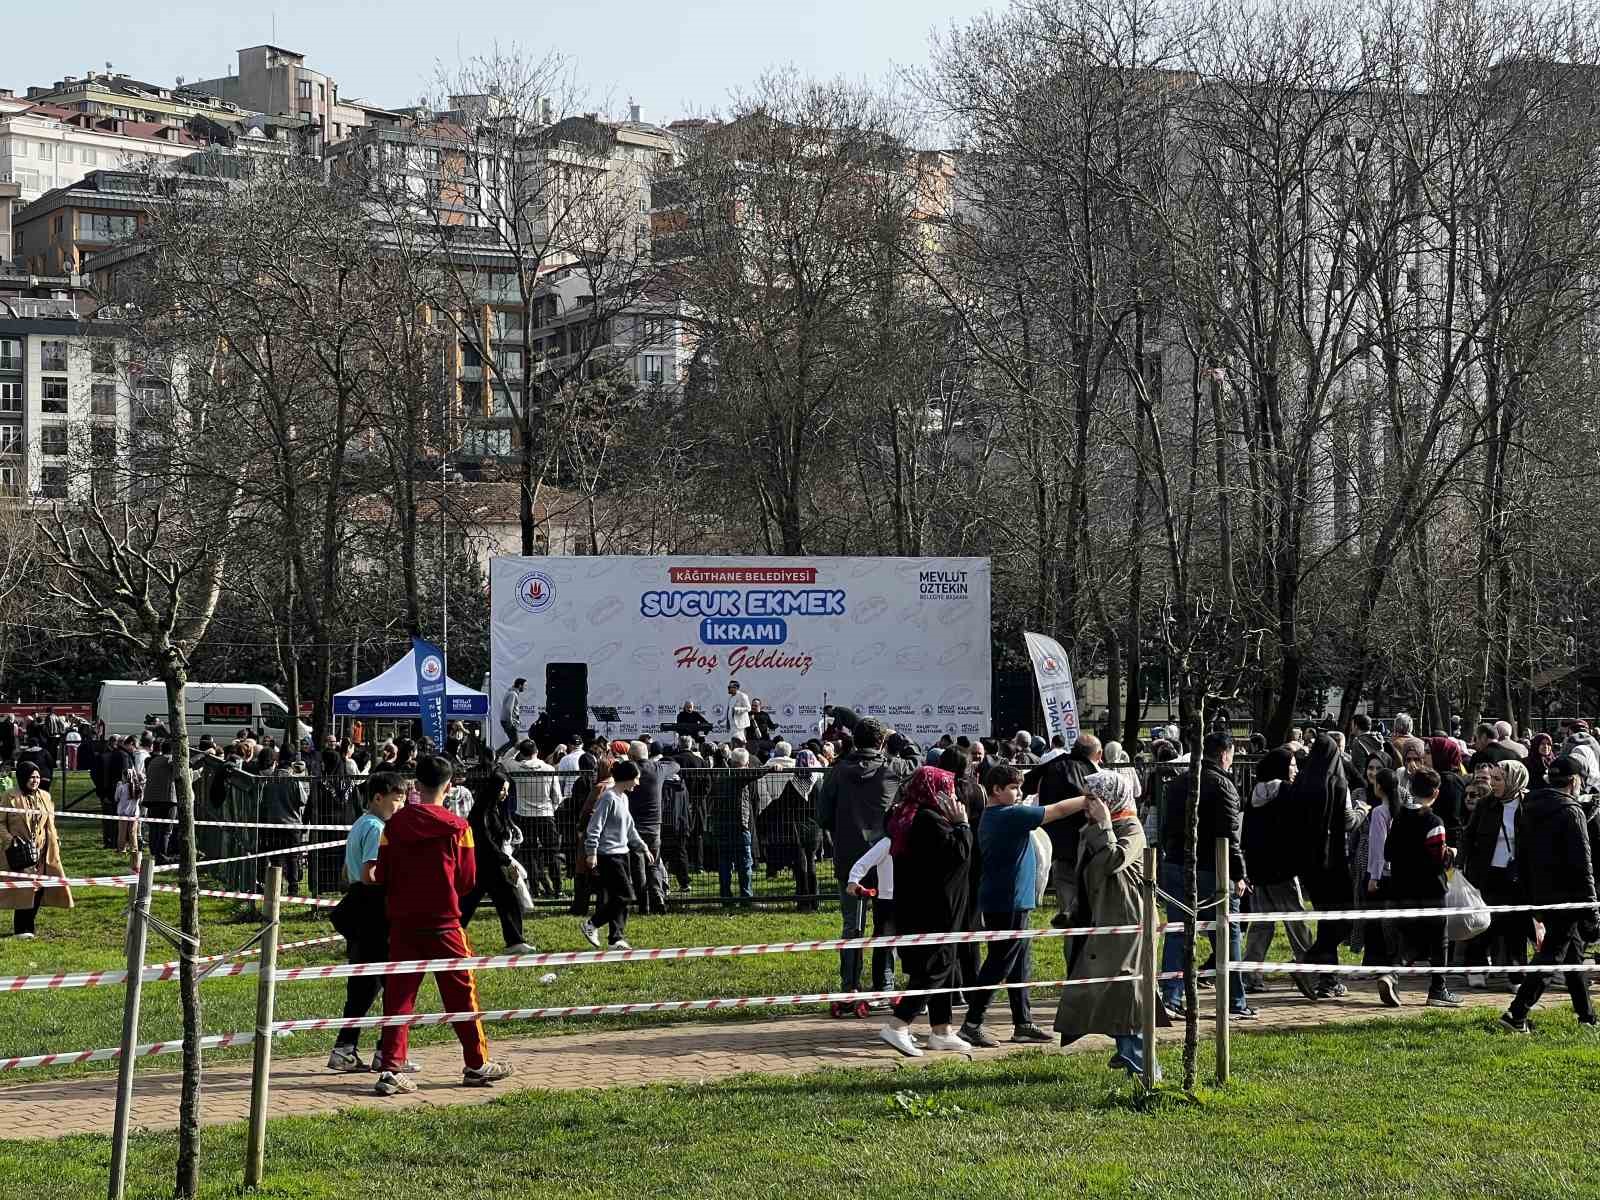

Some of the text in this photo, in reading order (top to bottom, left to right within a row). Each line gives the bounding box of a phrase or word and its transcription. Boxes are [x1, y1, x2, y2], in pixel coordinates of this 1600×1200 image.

[745, 569, 810, 581] BELEDİYESİ
[641, 589, 845, 617] SUCUK EKMEK
[705, 619, 781, 640] İKRAMI
[673, 646, 813, 675] Hoş Geldiniz
